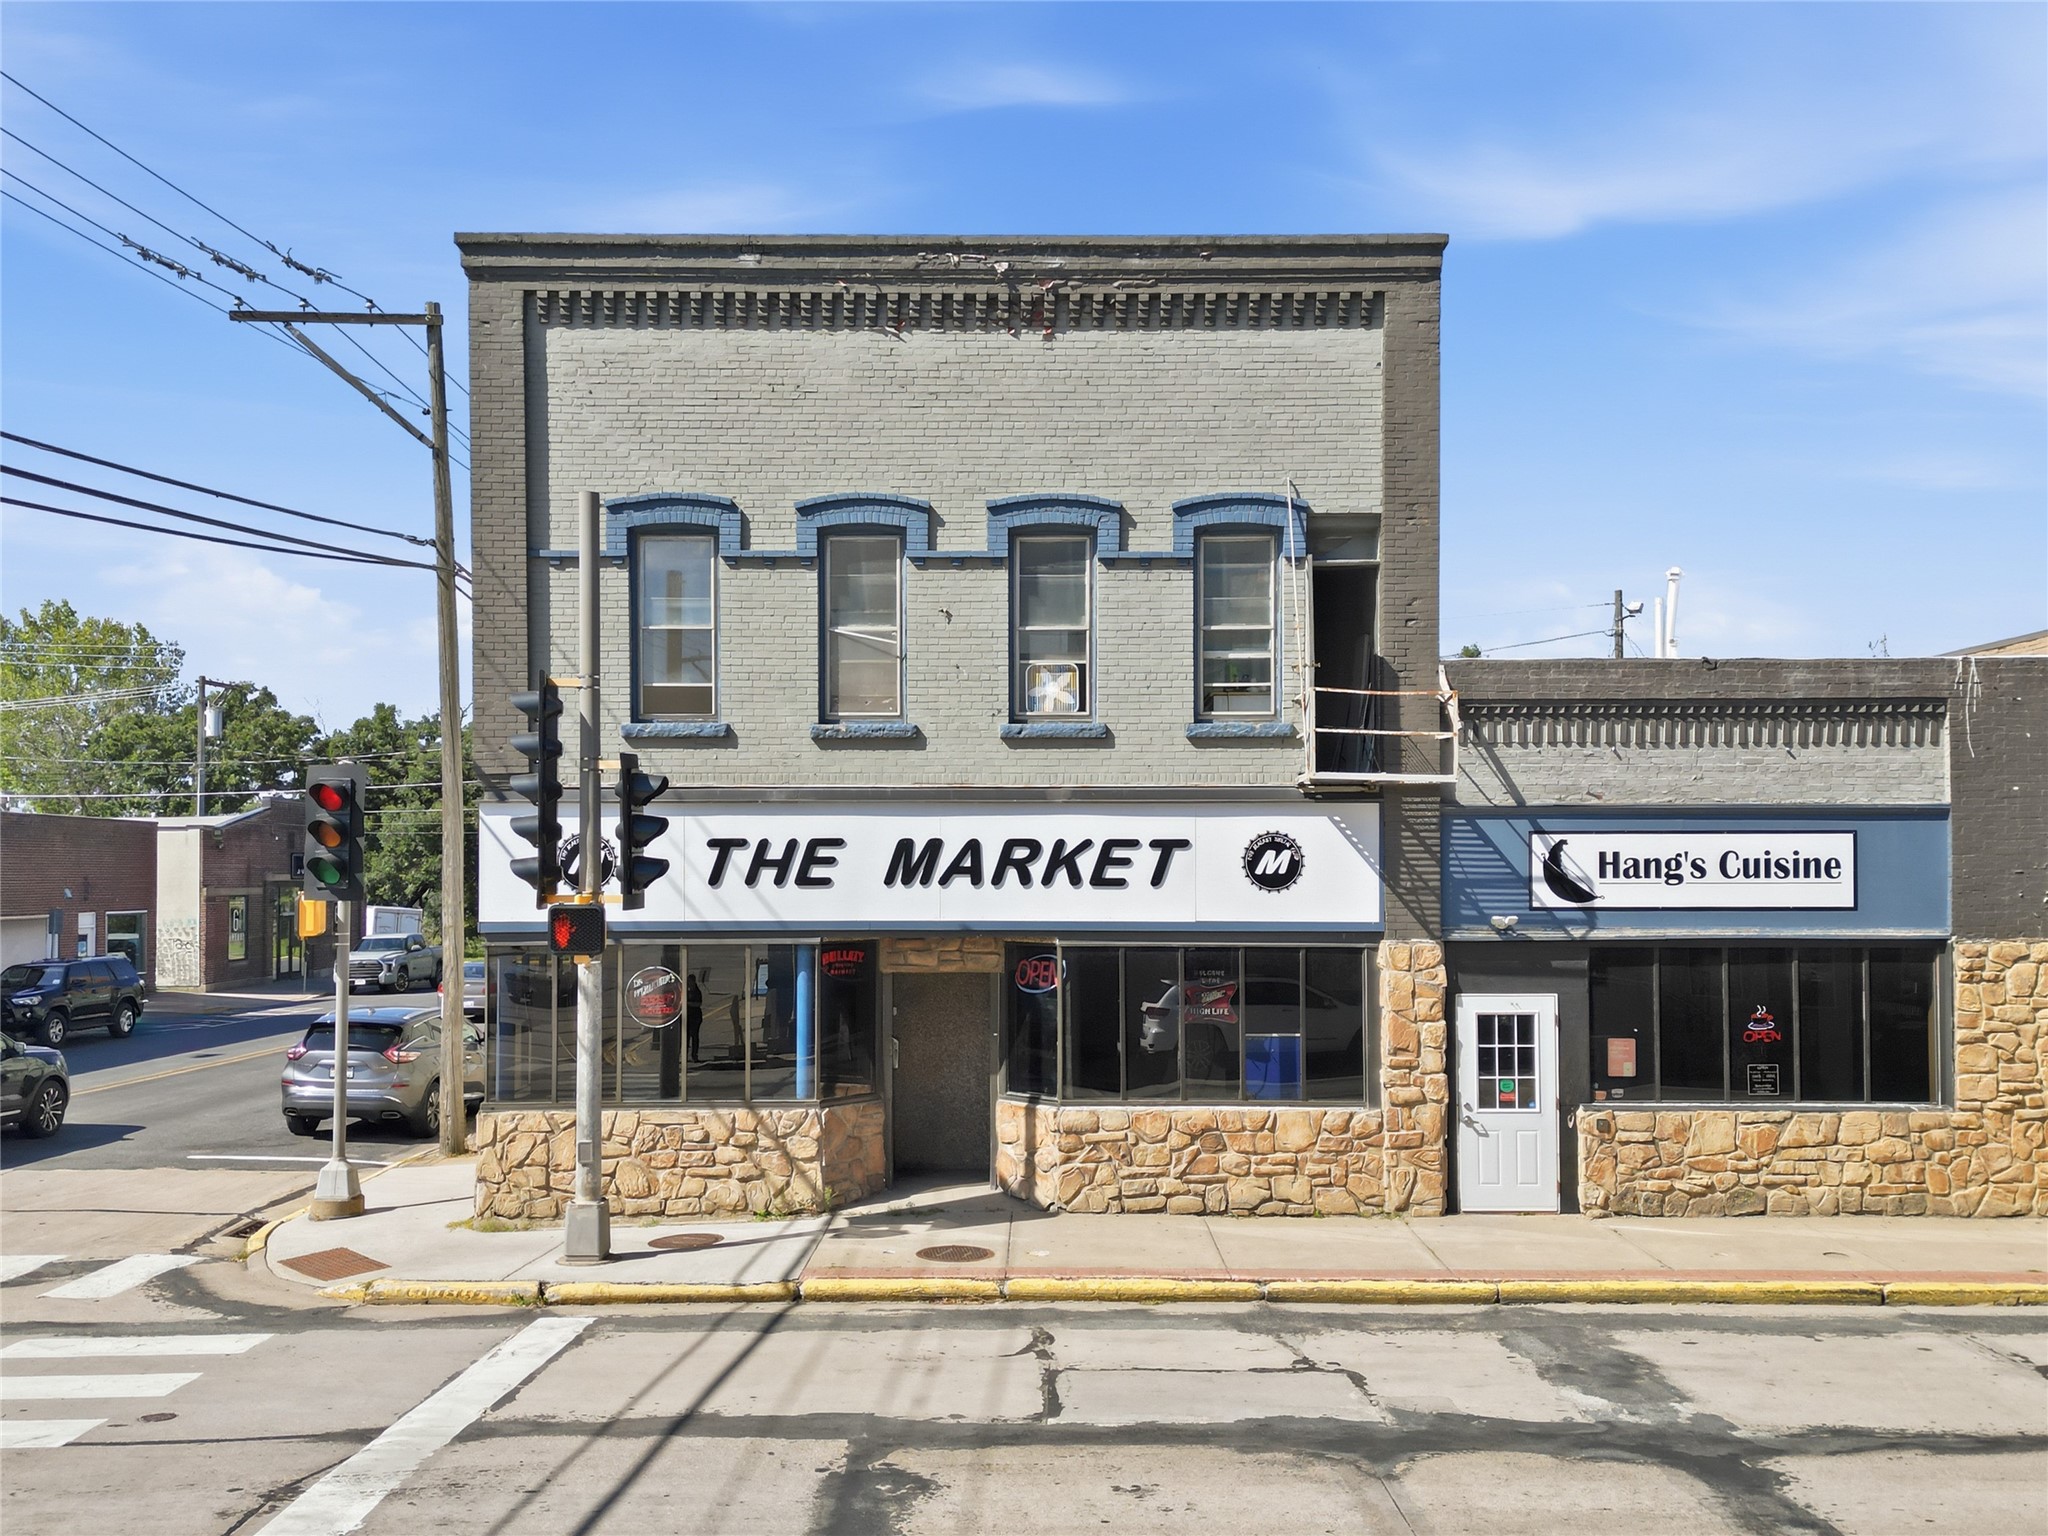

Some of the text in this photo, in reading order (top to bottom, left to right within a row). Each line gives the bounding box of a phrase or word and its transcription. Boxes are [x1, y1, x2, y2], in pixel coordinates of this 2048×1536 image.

[706, 837, 1193, 890] THE MARKET
[1254, 849, 1292, 875] M
[1598, 850, 1842, 886] Hang's Cuisine
[1017, 959, 1058, 987] OPEN
[1211, 1007, 1230, 1015] LIFE
[1743, 1030, 1782, 1043] OPEN
